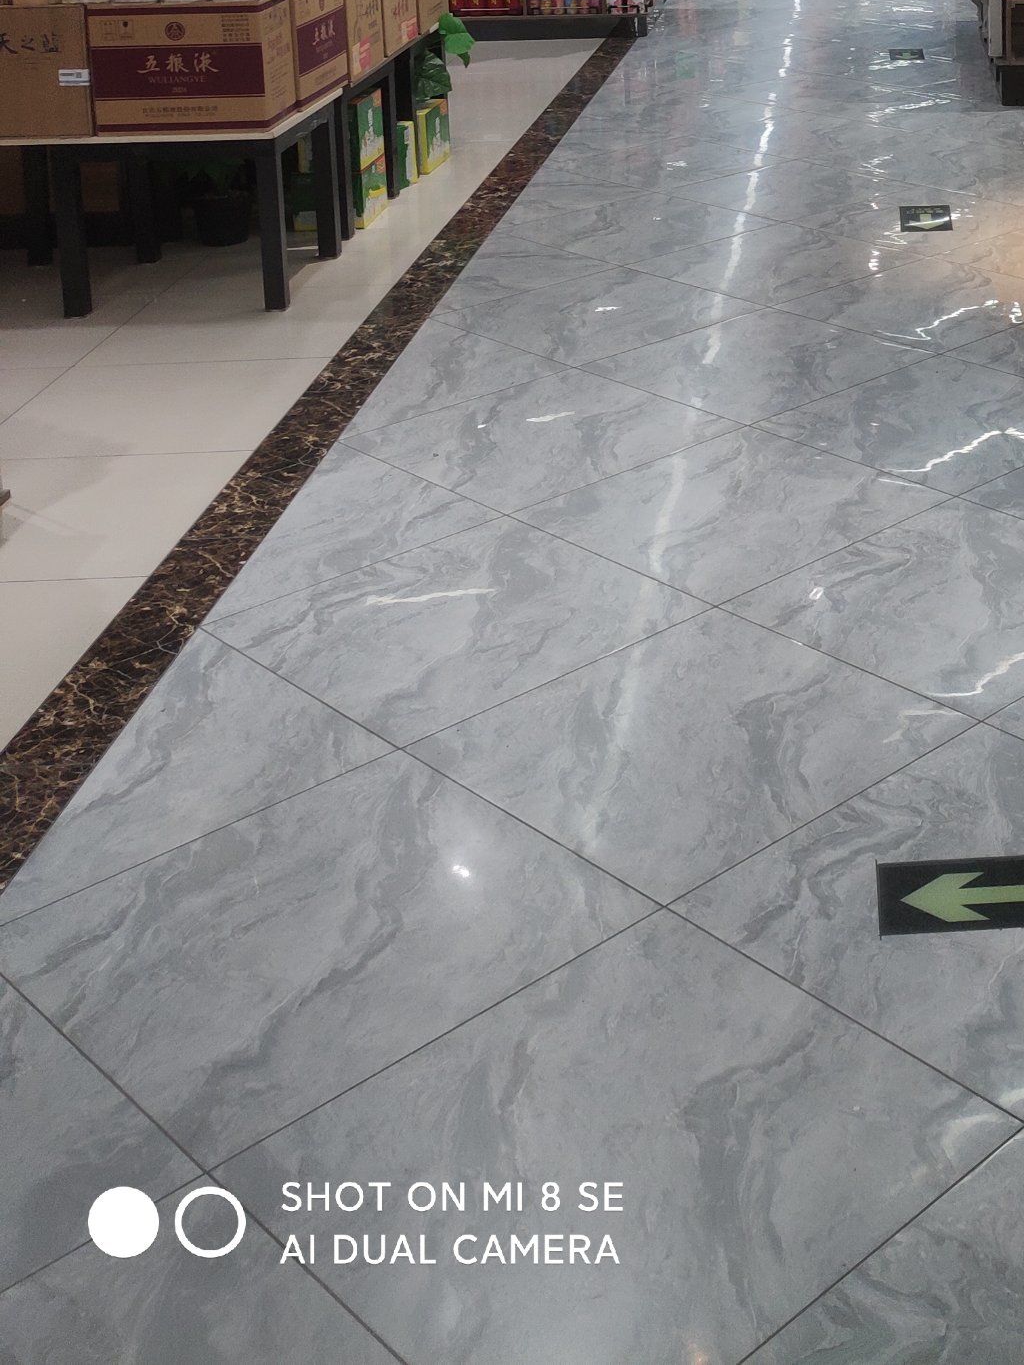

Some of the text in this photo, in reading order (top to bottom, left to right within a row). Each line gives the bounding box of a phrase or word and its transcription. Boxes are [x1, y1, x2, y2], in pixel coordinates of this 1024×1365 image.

[137, 52, 220, 75] 五粮液
[150, 75, 208, 84] WULIANGYE
